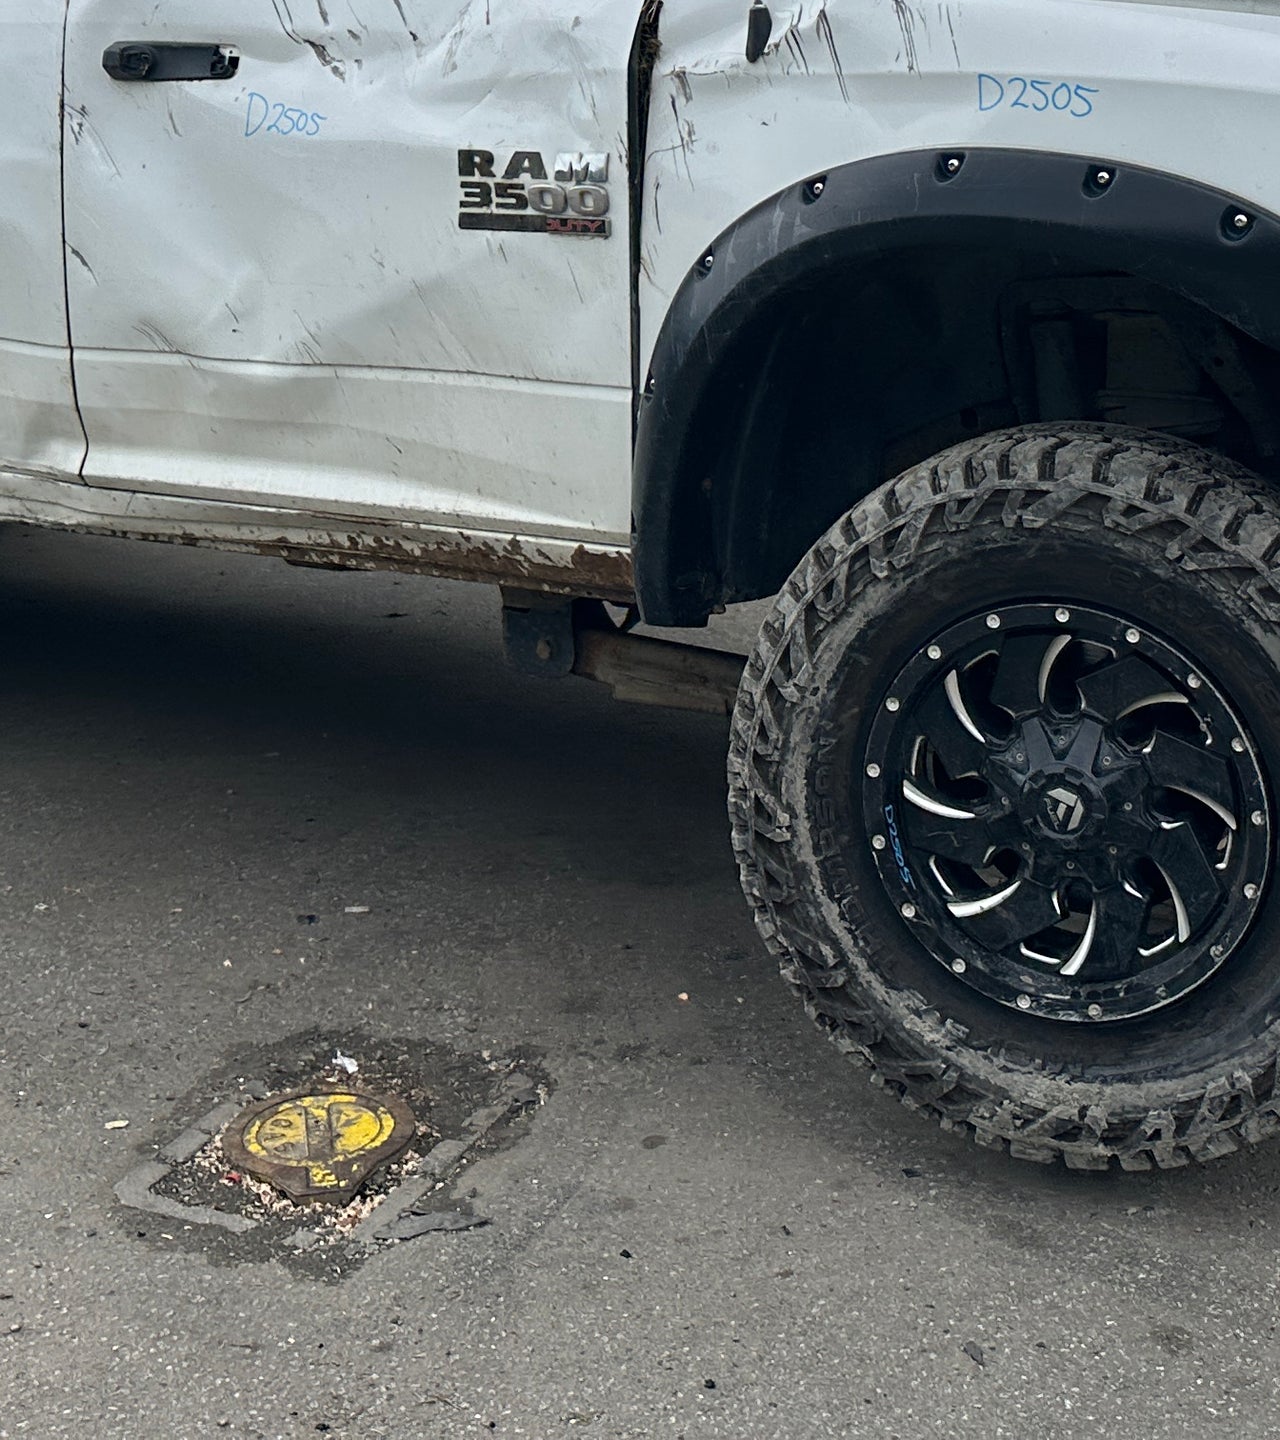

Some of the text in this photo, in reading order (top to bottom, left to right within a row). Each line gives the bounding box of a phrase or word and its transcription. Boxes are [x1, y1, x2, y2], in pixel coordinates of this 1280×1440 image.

[244, 92, 328, 137] D2505
[977, 73, 1100, 117] D2505
[458, 149, 610, 182] RAM
[459, 181, 610, 217] 3500
[884, 804, 917, 891] D2505
